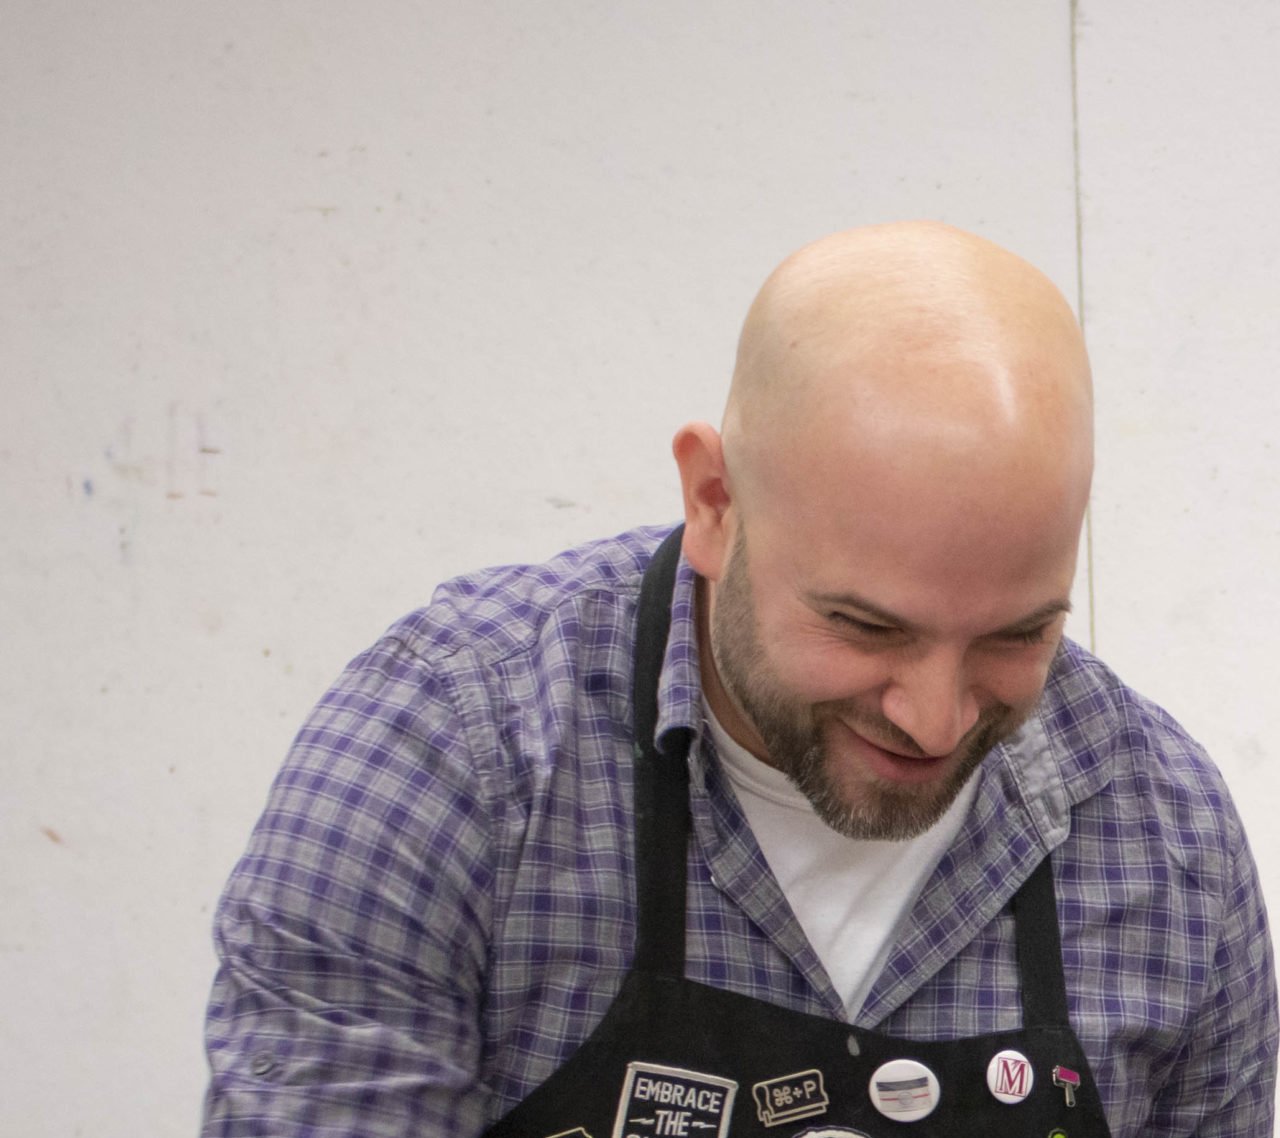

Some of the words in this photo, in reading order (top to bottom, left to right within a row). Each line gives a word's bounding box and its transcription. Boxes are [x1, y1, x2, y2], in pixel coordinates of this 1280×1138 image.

[635, 1078, 722, 1113] EMBRACE
[999, 1060, 1026, 1096] M
[656, 1110, 691, 1136] THE
